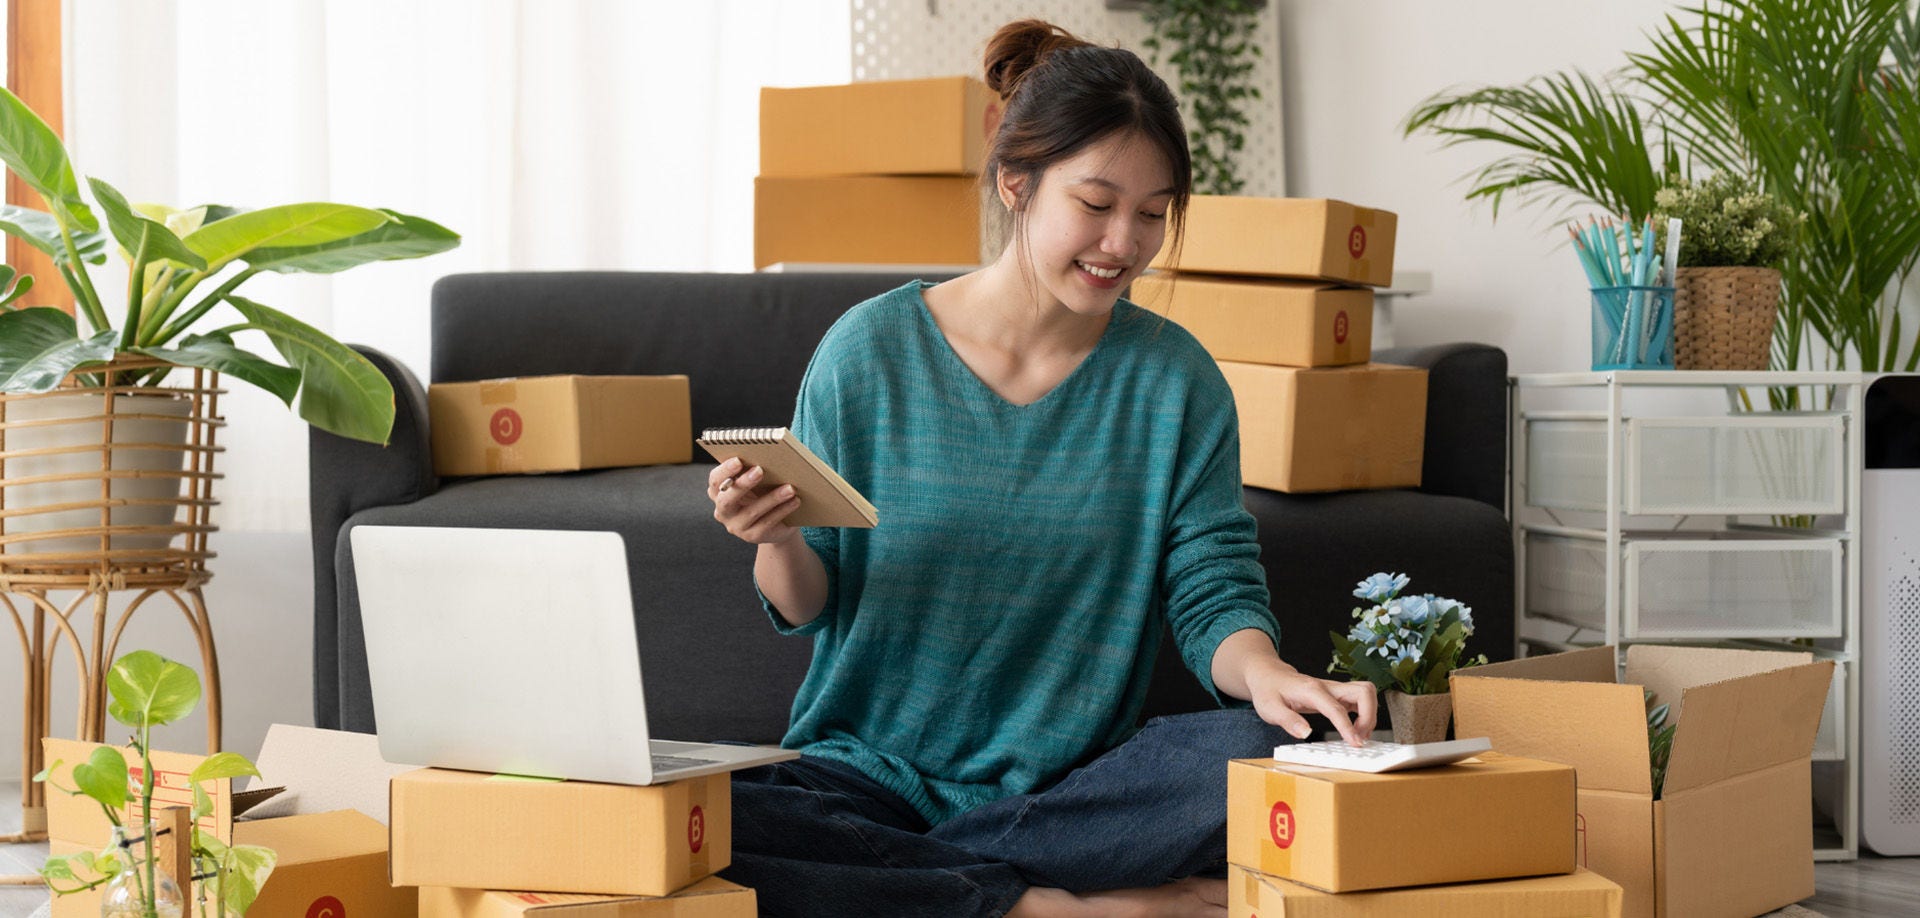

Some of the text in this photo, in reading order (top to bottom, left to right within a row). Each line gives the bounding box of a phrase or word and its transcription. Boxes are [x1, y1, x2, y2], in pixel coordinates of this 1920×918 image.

[1352, 231, 1362, 251] B
[1337, 317, 1345, 336] B
[499, 416, 513, 437] C
[692, 816, 701, 843] B
[1275, 812, 1289, 840] B
